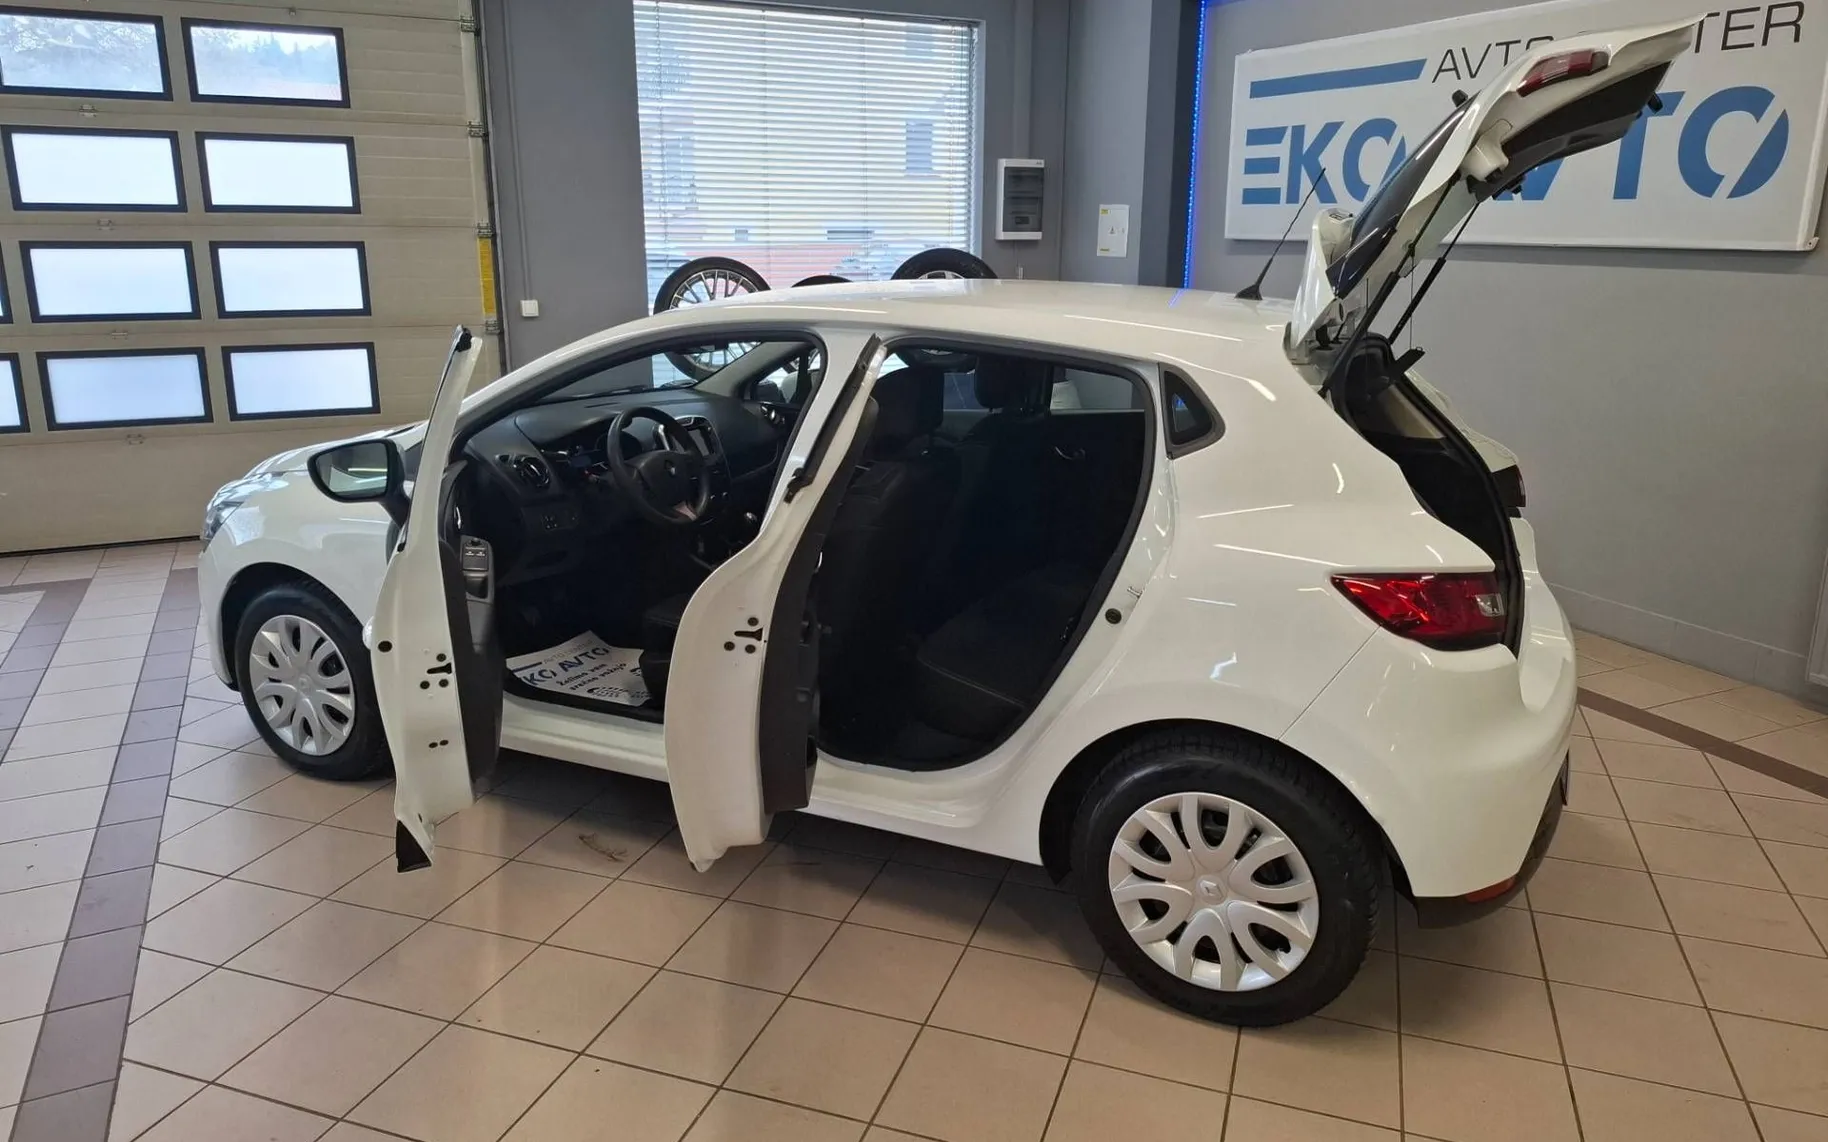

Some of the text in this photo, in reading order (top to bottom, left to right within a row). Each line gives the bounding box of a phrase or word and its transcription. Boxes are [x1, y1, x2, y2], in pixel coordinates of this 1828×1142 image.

[1694, 1, 1805, 53] TER
[1241, 86, 1790, 205] EKO TO
[522, 668, 558, 686] KO
[558, 647, 610, 672] AVTO
